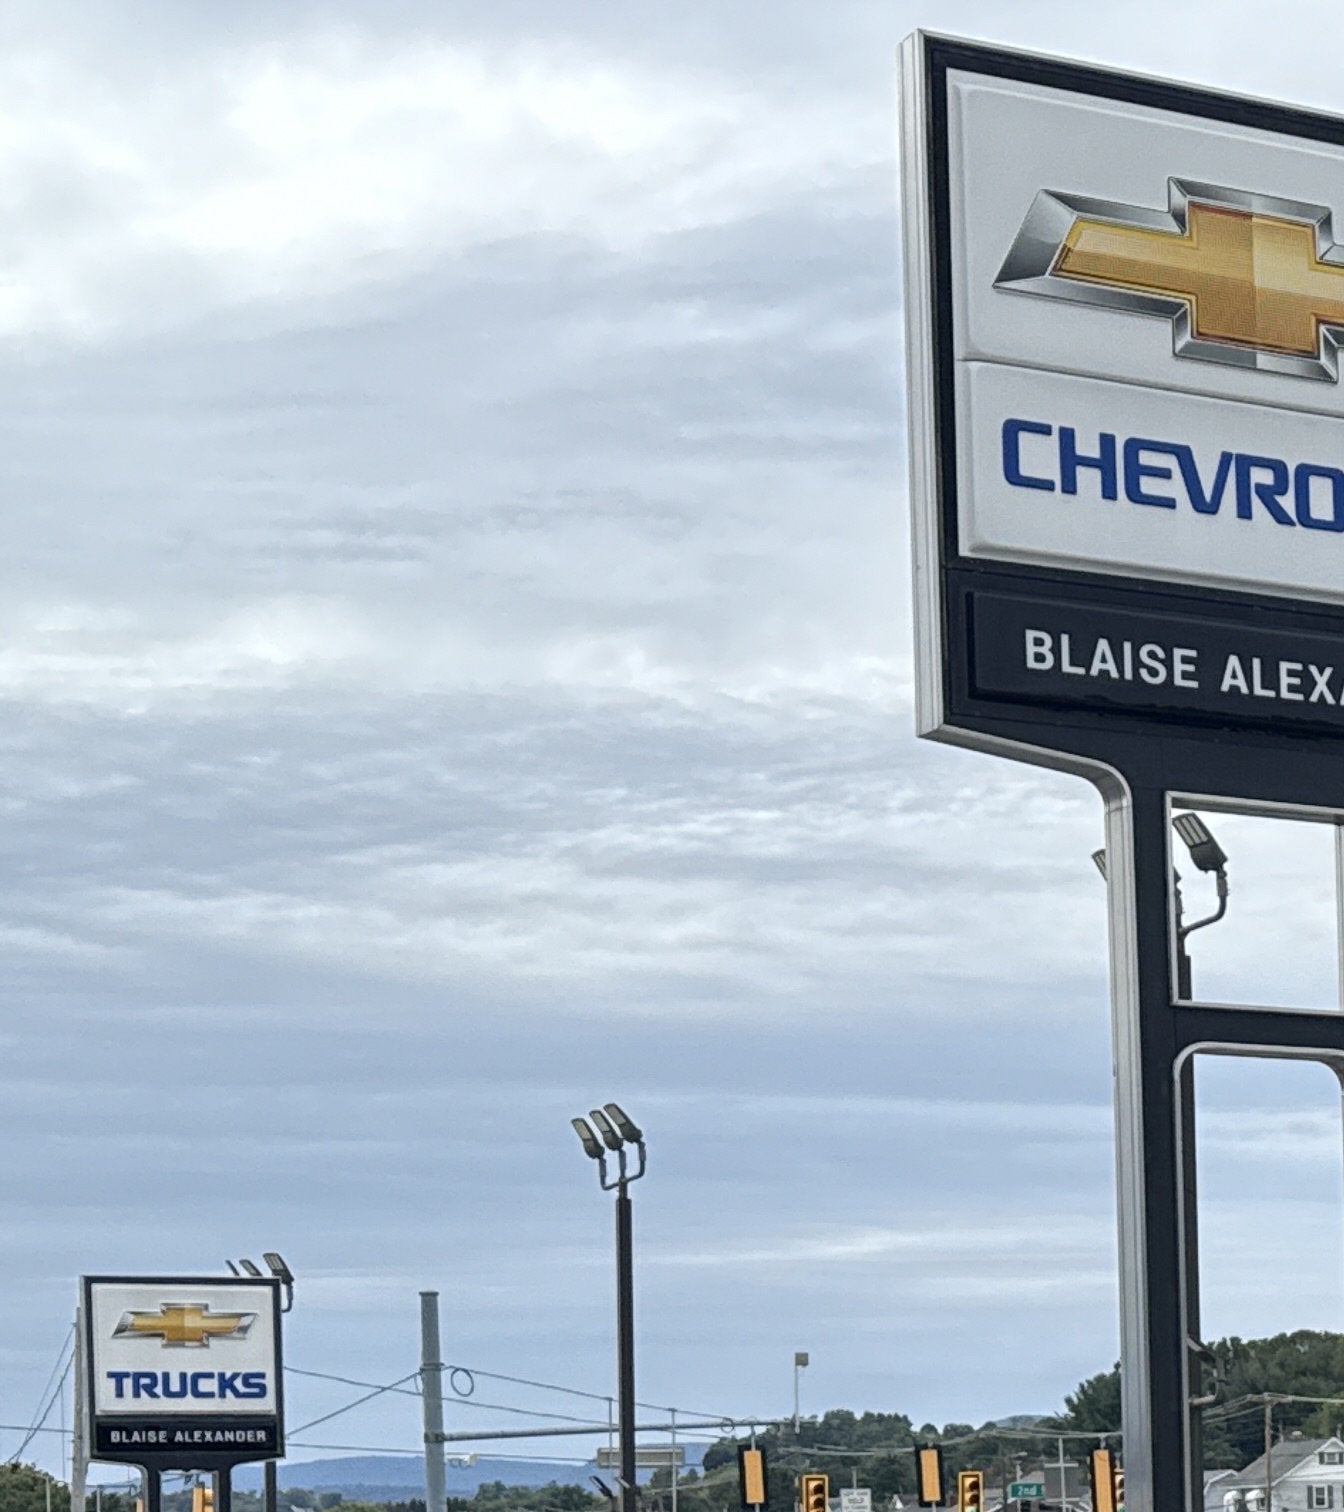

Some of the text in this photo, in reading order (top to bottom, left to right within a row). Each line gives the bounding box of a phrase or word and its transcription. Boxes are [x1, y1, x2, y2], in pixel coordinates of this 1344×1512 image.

[1024, 628, 1199, 690] BLAISE
[107, 1371, 267, 1399] TRUCKS
[110, 1430, 267, 1444] BLAISE ALEXANDER
